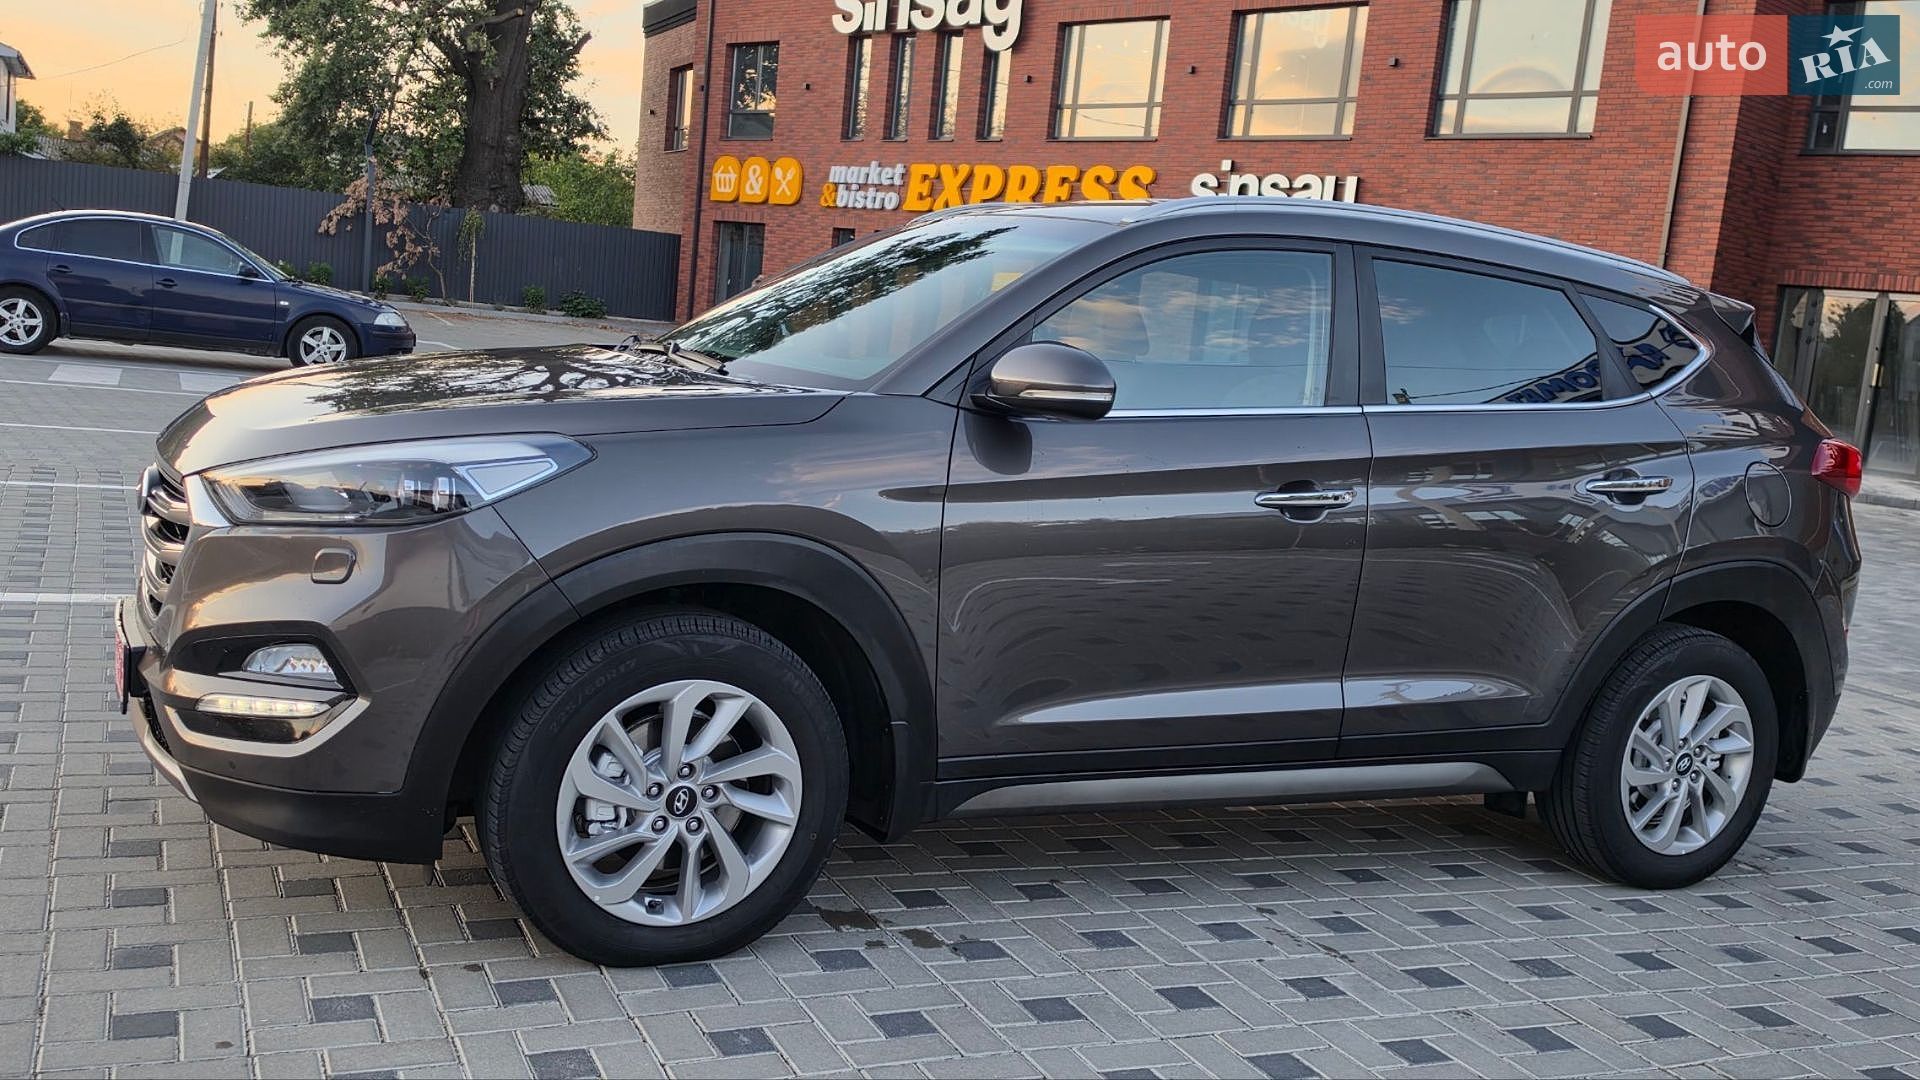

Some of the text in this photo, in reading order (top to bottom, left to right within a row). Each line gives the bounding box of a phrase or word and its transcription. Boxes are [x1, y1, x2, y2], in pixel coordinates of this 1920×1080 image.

[829, 160, 906, 186] market
[820, 182, 901, 210] &bistro
[903, 163, 1157, 212] EXPRESS
